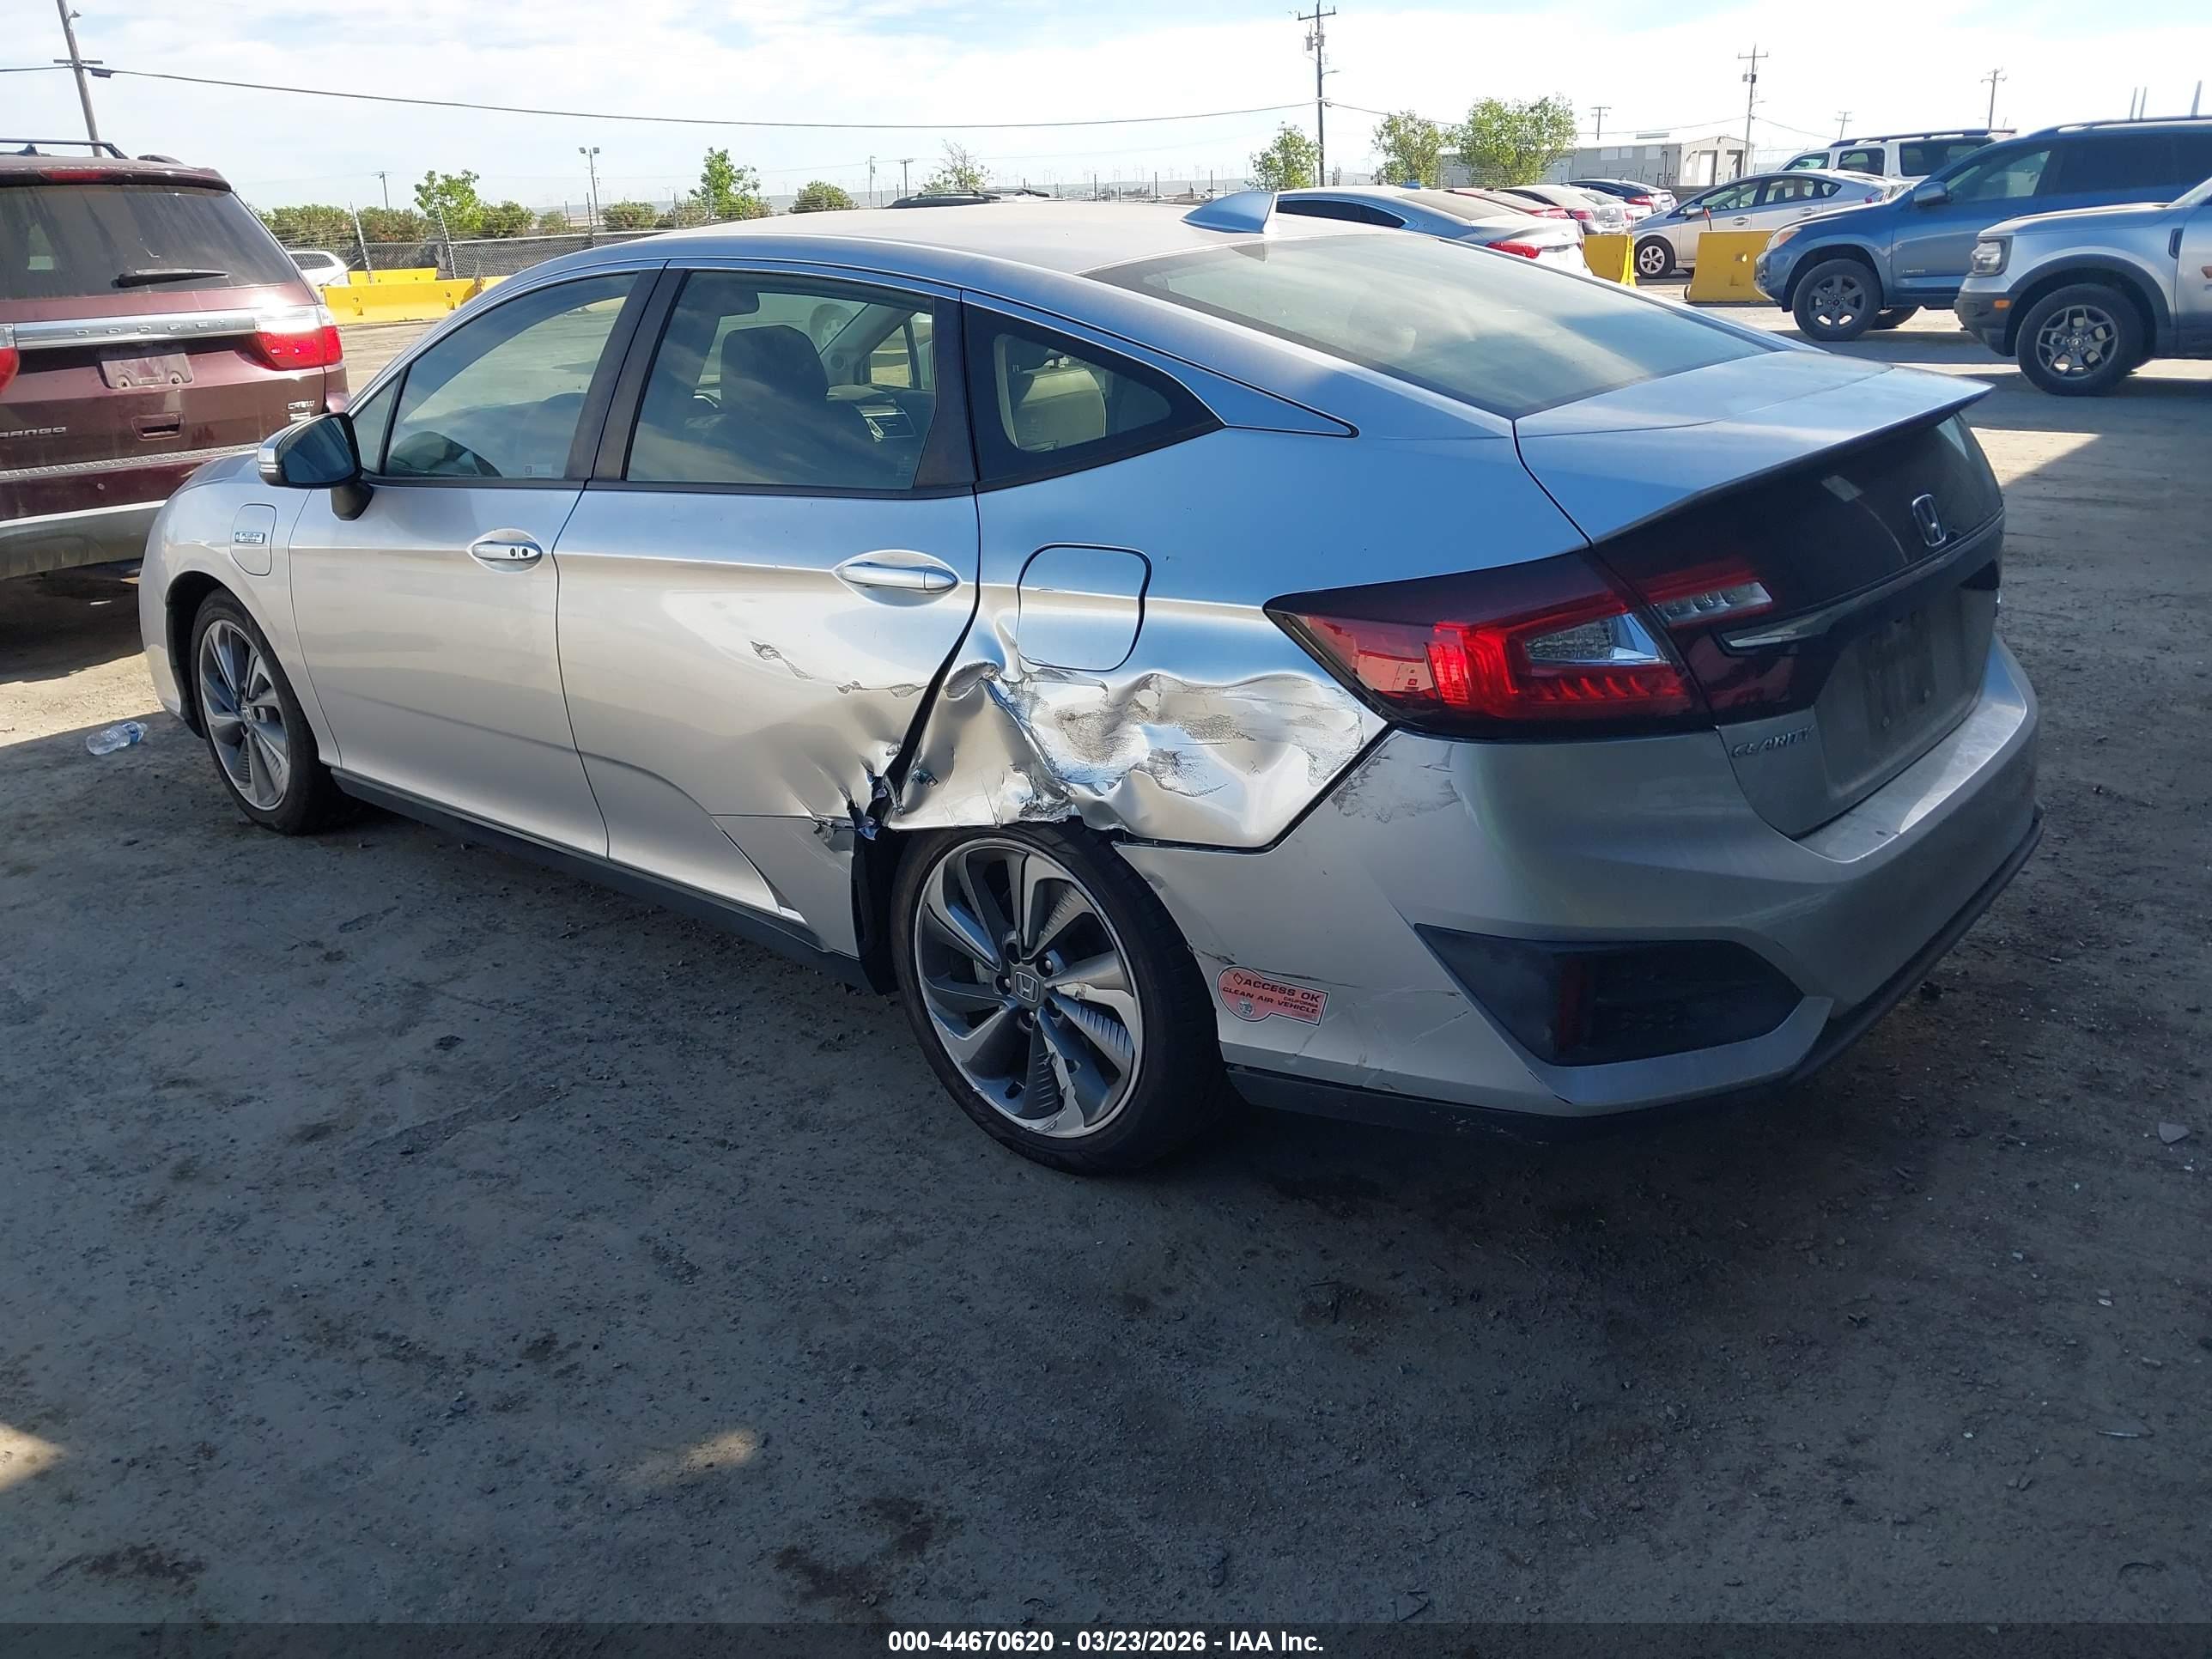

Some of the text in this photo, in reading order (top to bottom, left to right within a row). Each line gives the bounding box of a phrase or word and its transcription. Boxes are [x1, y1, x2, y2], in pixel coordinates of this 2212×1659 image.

[75, 320, 208, 336] DODGE
[1222, 986, 1318, 1015] CLEAN AIR VEHICLE
[1243, 978, 1320, 1003] ACCESS OK
